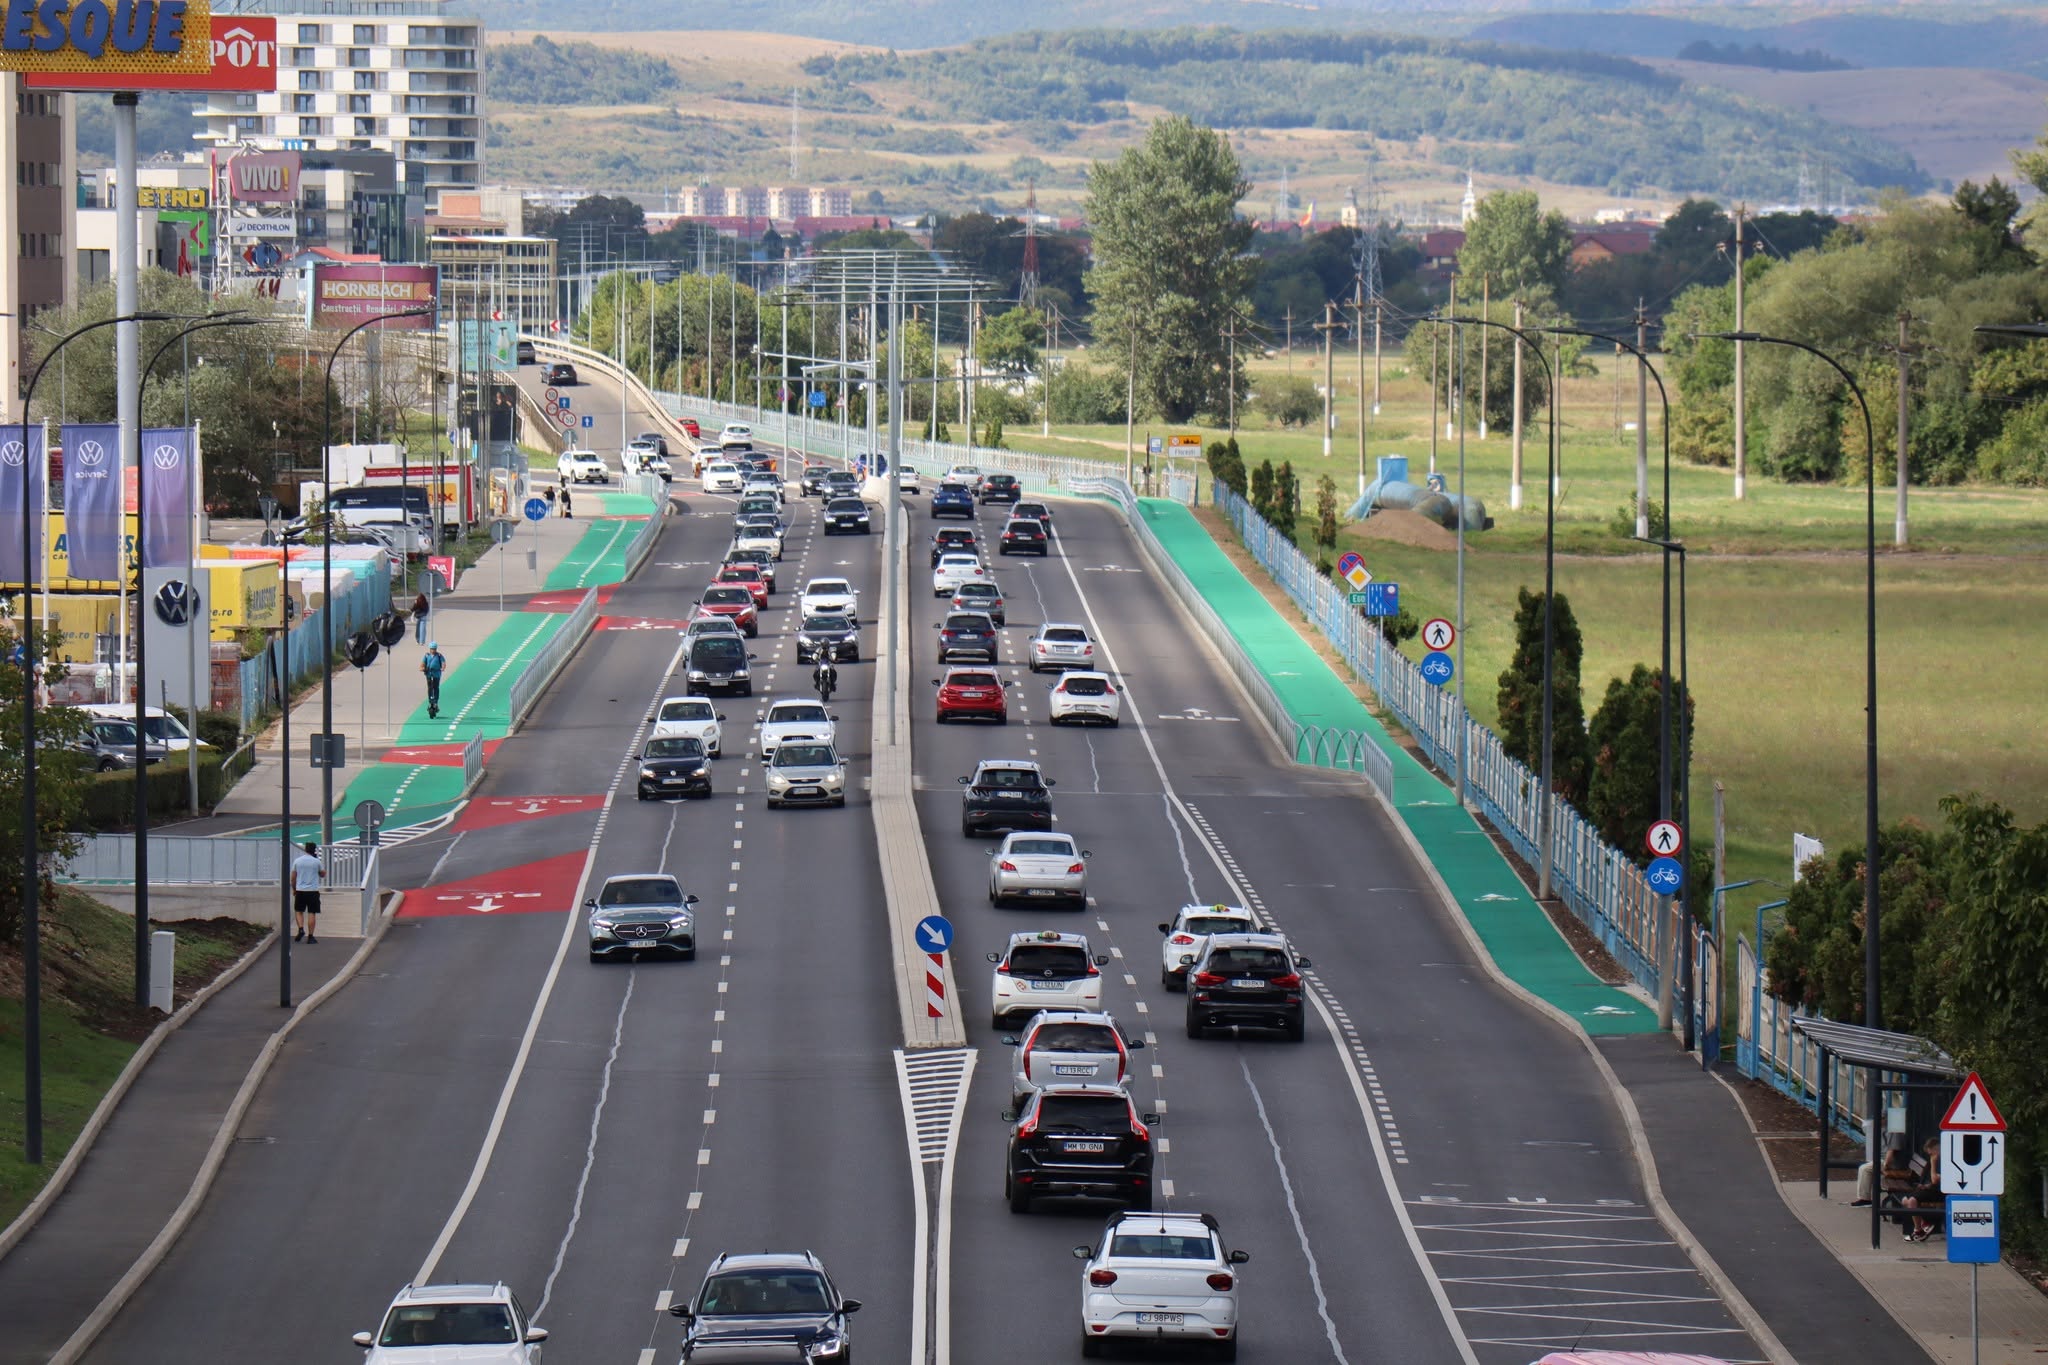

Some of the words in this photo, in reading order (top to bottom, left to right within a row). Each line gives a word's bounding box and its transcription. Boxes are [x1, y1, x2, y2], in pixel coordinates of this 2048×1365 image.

[240, 165, 290, 192] VIVO!
[138, 188, 206, 208] ETRO
[247, 224, 290, 232] DECATHLON
[323, 282, 412, 297] HORNBACH
[62, 631, 90, 640] ue.ro
[1141, 1313, 1151, 1321] CJ
